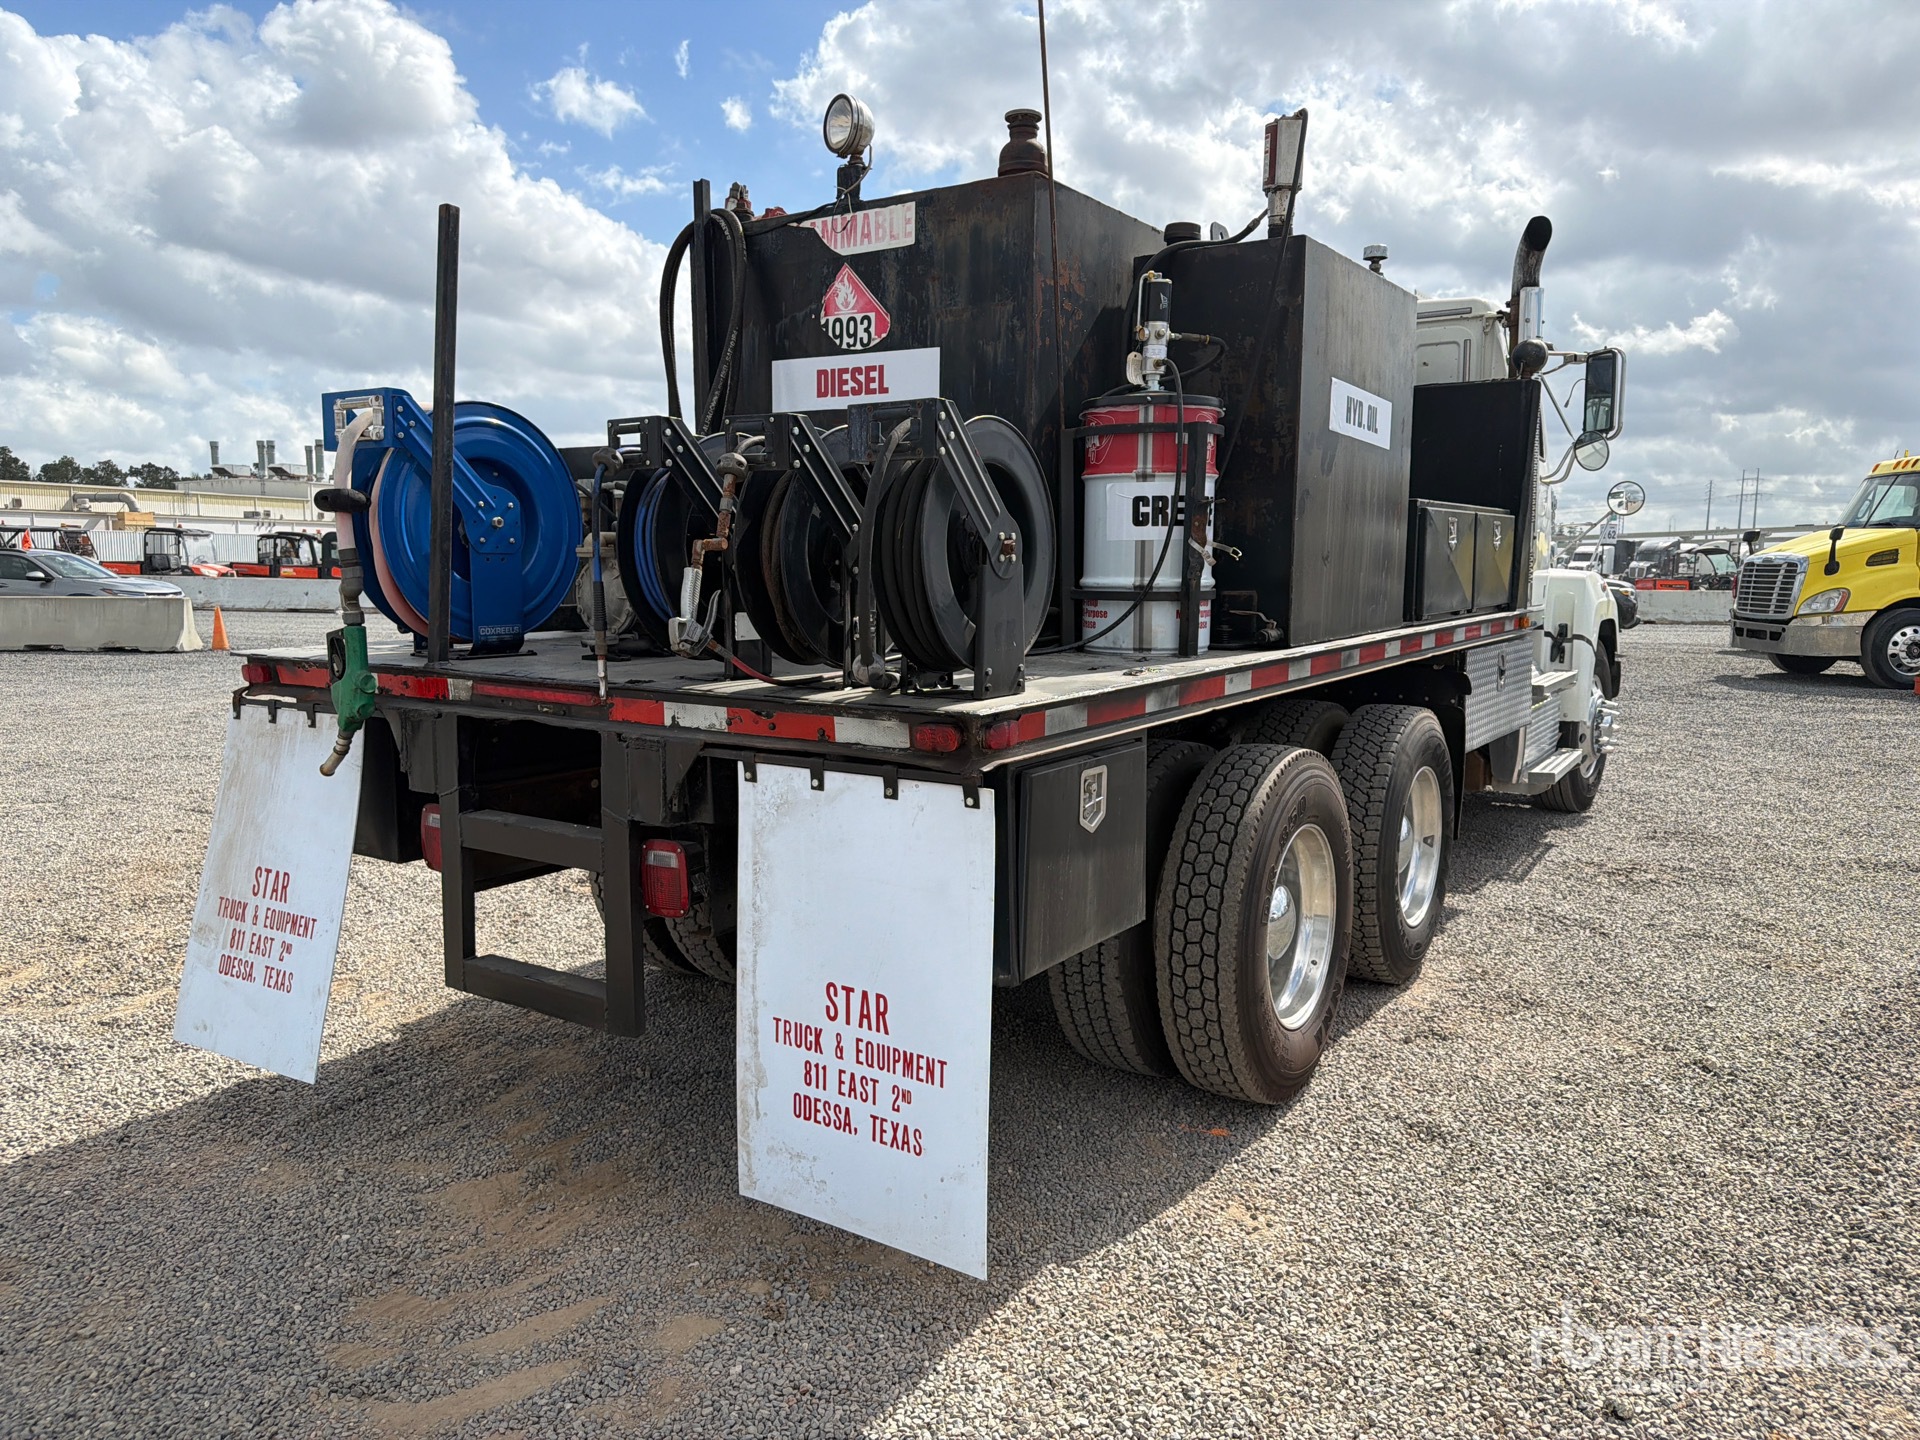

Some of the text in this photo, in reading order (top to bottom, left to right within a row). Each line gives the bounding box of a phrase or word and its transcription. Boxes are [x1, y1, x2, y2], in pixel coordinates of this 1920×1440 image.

[810, 205, 913, 249] MMABLE
[816, 364, 889, 399] DIESEL
[1345, 395, 1379, 434] HYD. OIL
[480, 626, 520, 636] COXREELS
[252, 866, 290, 904] STAR
[217, 896, 317, 940] TRUCK & EQUIPMENT
[229, 928, 246, 951] 811
[248, 932, 275, 959] EAST
[218, 953, 294, 994] ODESSA, TEXAS
[825, 981, 890, 1036] STAR
[772, 1016, 948, 1089] TRUCK & EQUIPMENT
[803, 1060, 827, 1091] 811
[838, 1068, 879, 1106] EAST
[793, 1092, 923, 1157] ODESSA, TEXAS
